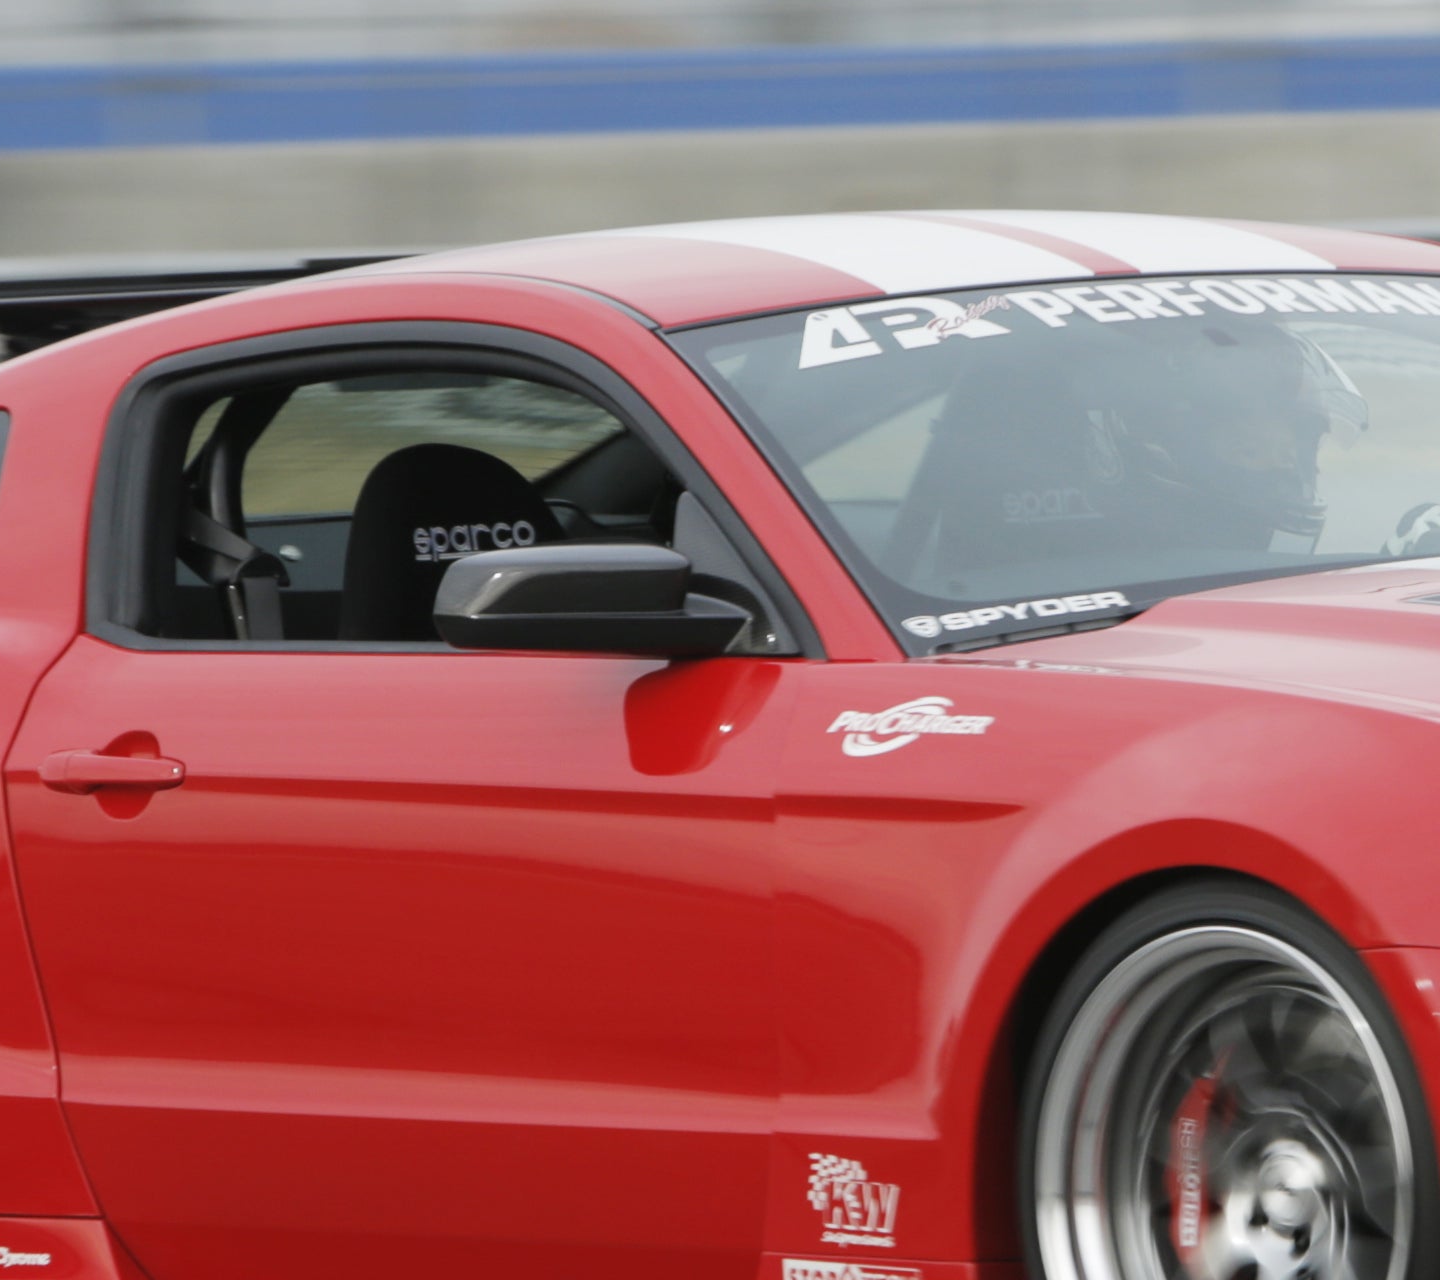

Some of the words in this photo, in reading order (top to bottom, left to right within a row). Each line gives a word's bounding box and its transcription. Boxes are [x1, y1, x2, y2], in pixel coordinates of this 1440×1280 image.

[413, 520, 535, 561] sparco
[940, 591, 1131, 631] SPYDER
[823, 1181, 900, 1234] KW
